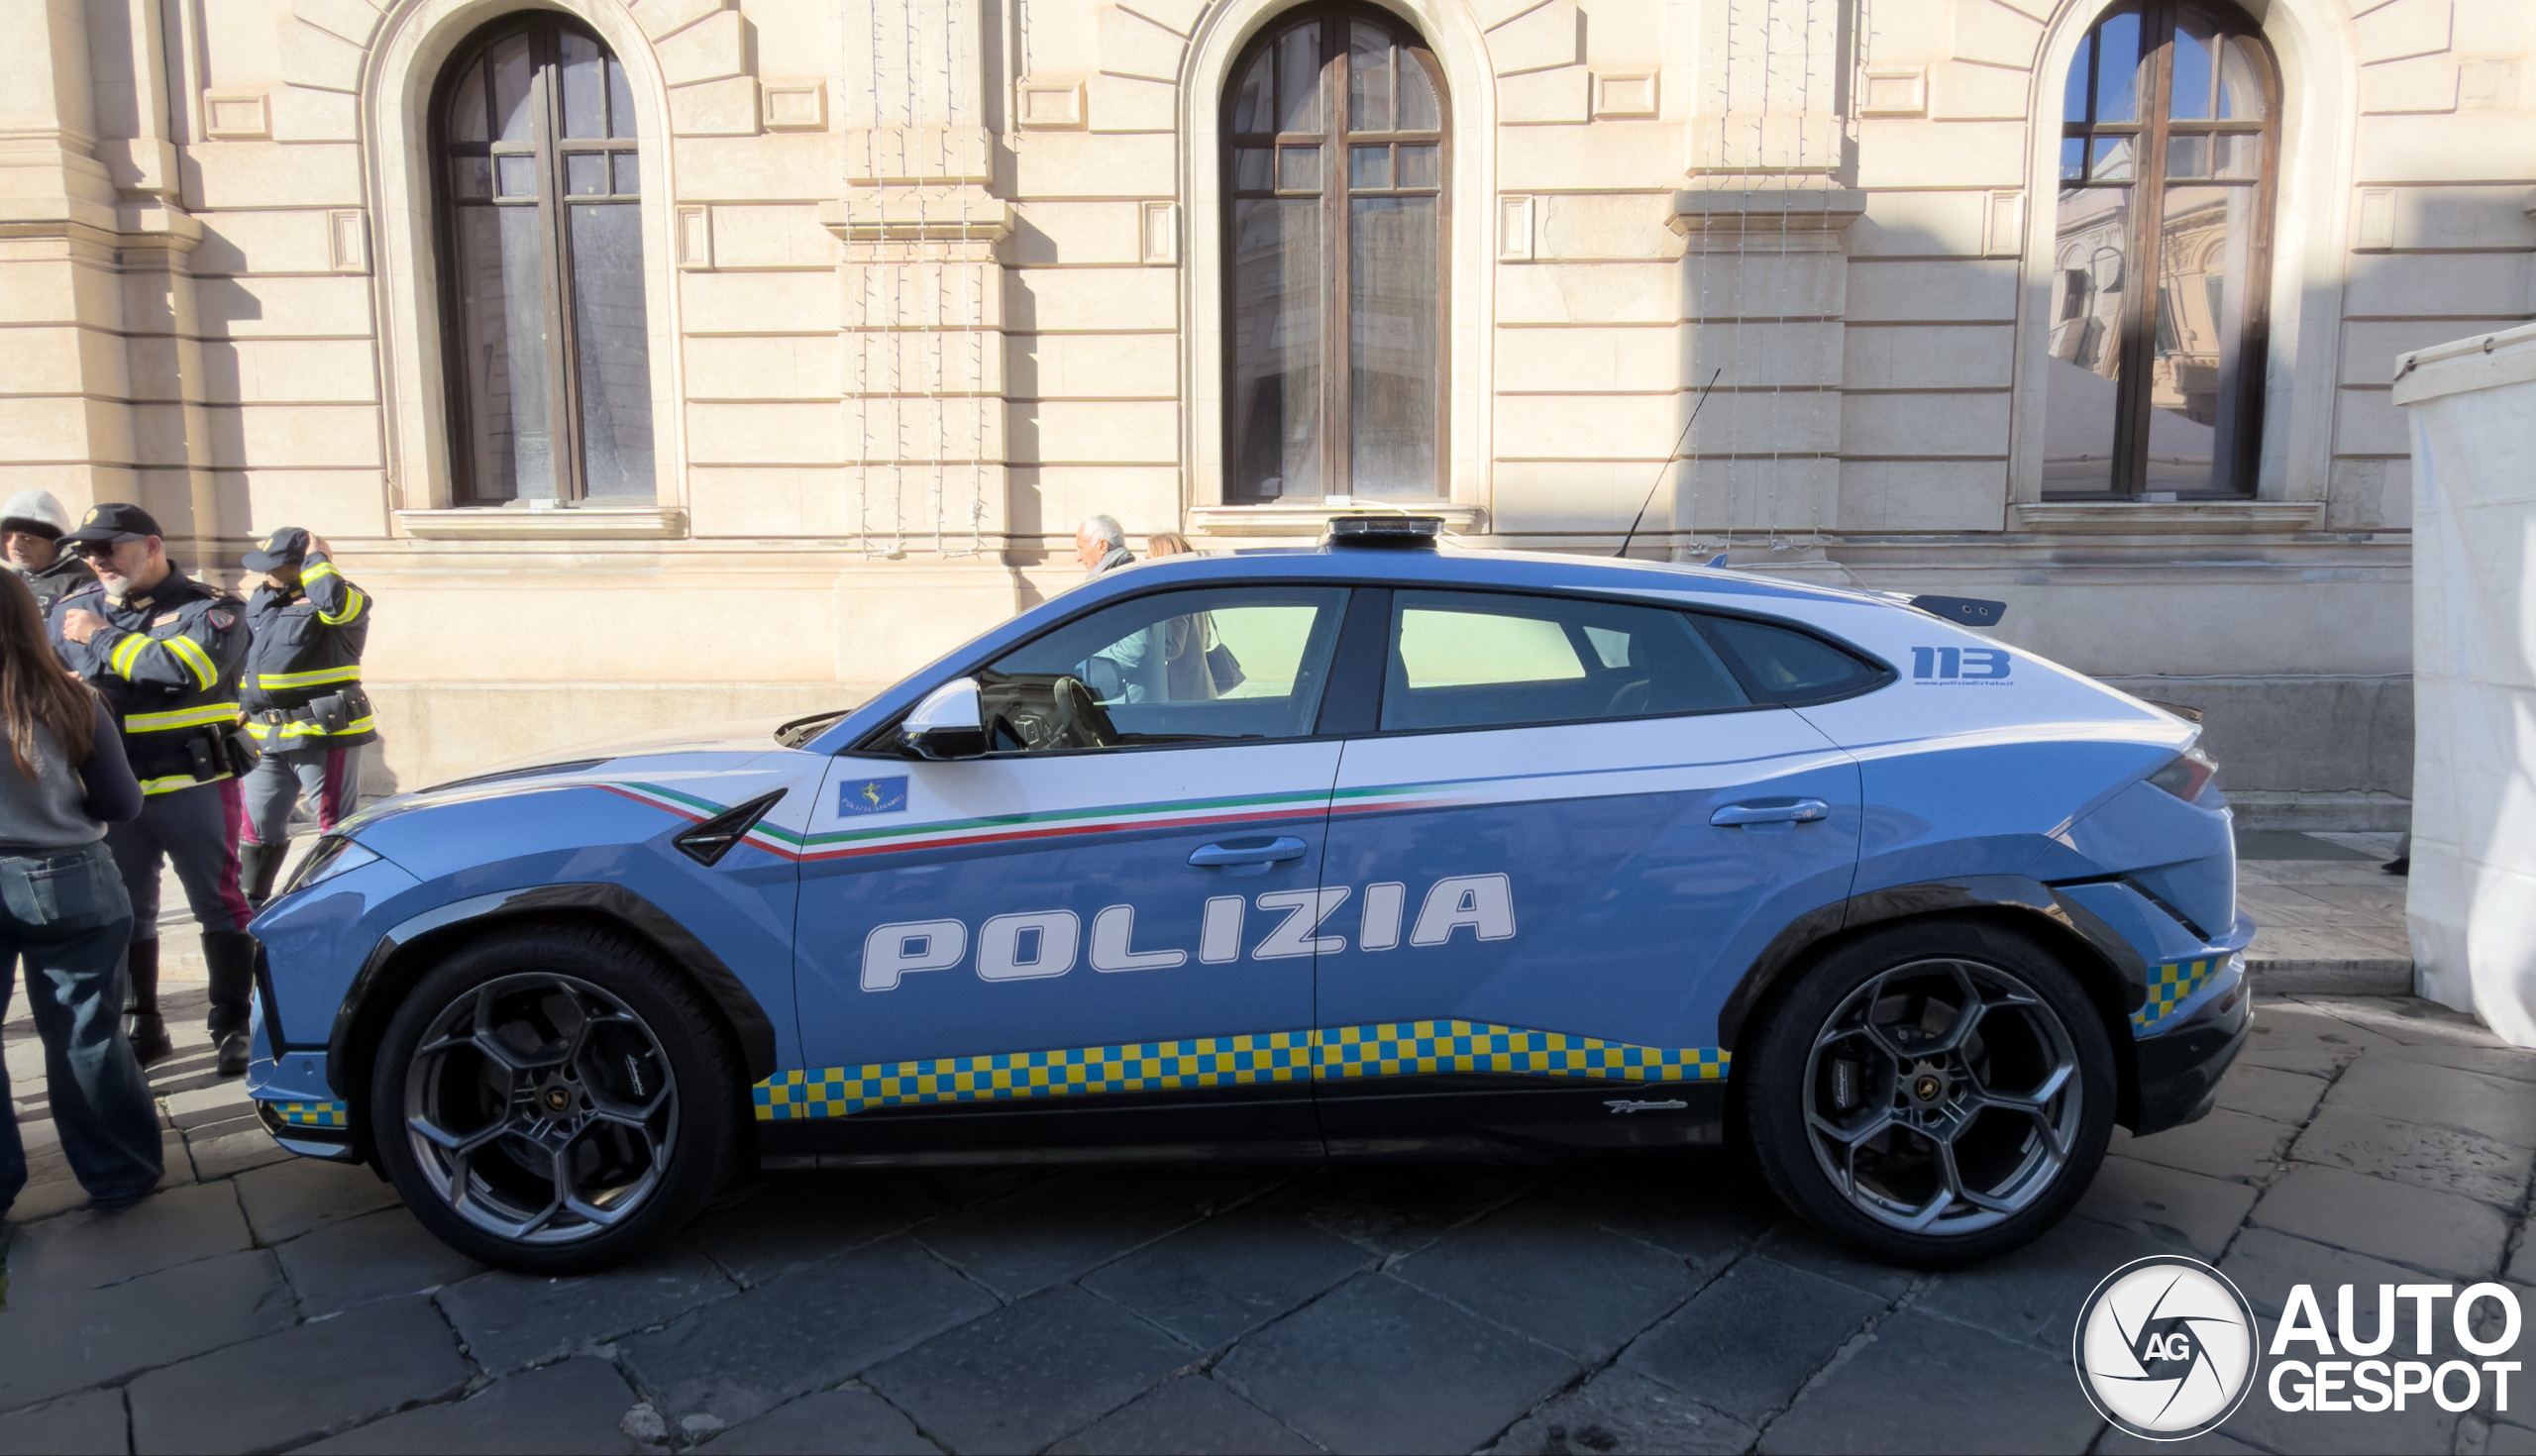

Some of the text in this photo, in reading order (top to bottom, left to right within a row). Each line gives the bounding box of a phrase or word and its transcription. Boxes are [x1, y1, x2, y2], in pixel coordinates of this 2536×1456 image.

[1911, 646, 2011, 679] 113
[841, 797, 873, 812] POLIZIA
[860, 873, 1517, 992] POLIZIA
